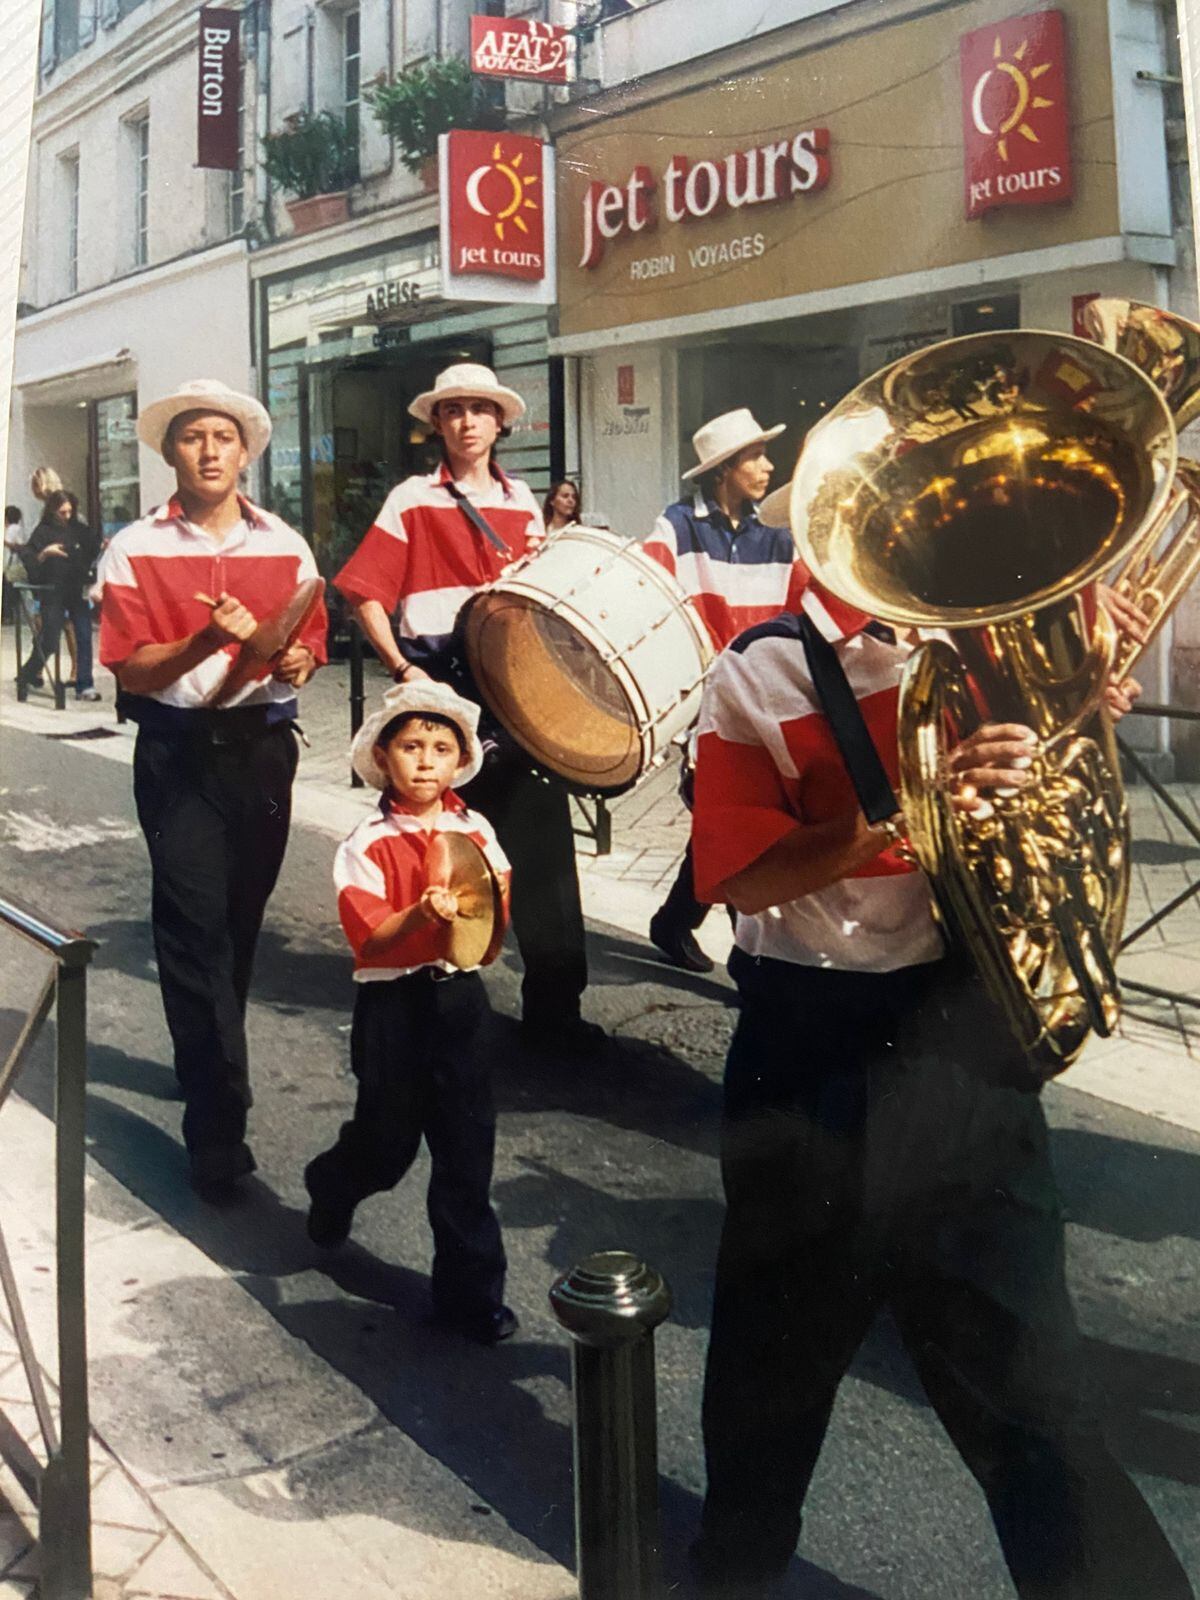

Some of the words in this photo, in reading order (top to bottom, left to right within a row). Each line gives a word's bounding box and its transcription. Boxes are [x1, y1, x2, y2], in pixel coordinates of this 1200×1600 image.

[474, 53, 540, 73] VOYAGES
[475, 30, 549, 64] AFAT
[202, 27, 231, 116] Burton
[578, 168, 649, 268] jet
[662, 129, 822, 223] tours
[969, 178, 992, 211] jet
[997, 166, 1061, 195] tours
[459, 246, 488, 269] jet
[493, 248, 542, 268] tours
[630, 255, 676, 280] ROBIN
[688, 233, 765, 268] VOYAGES
